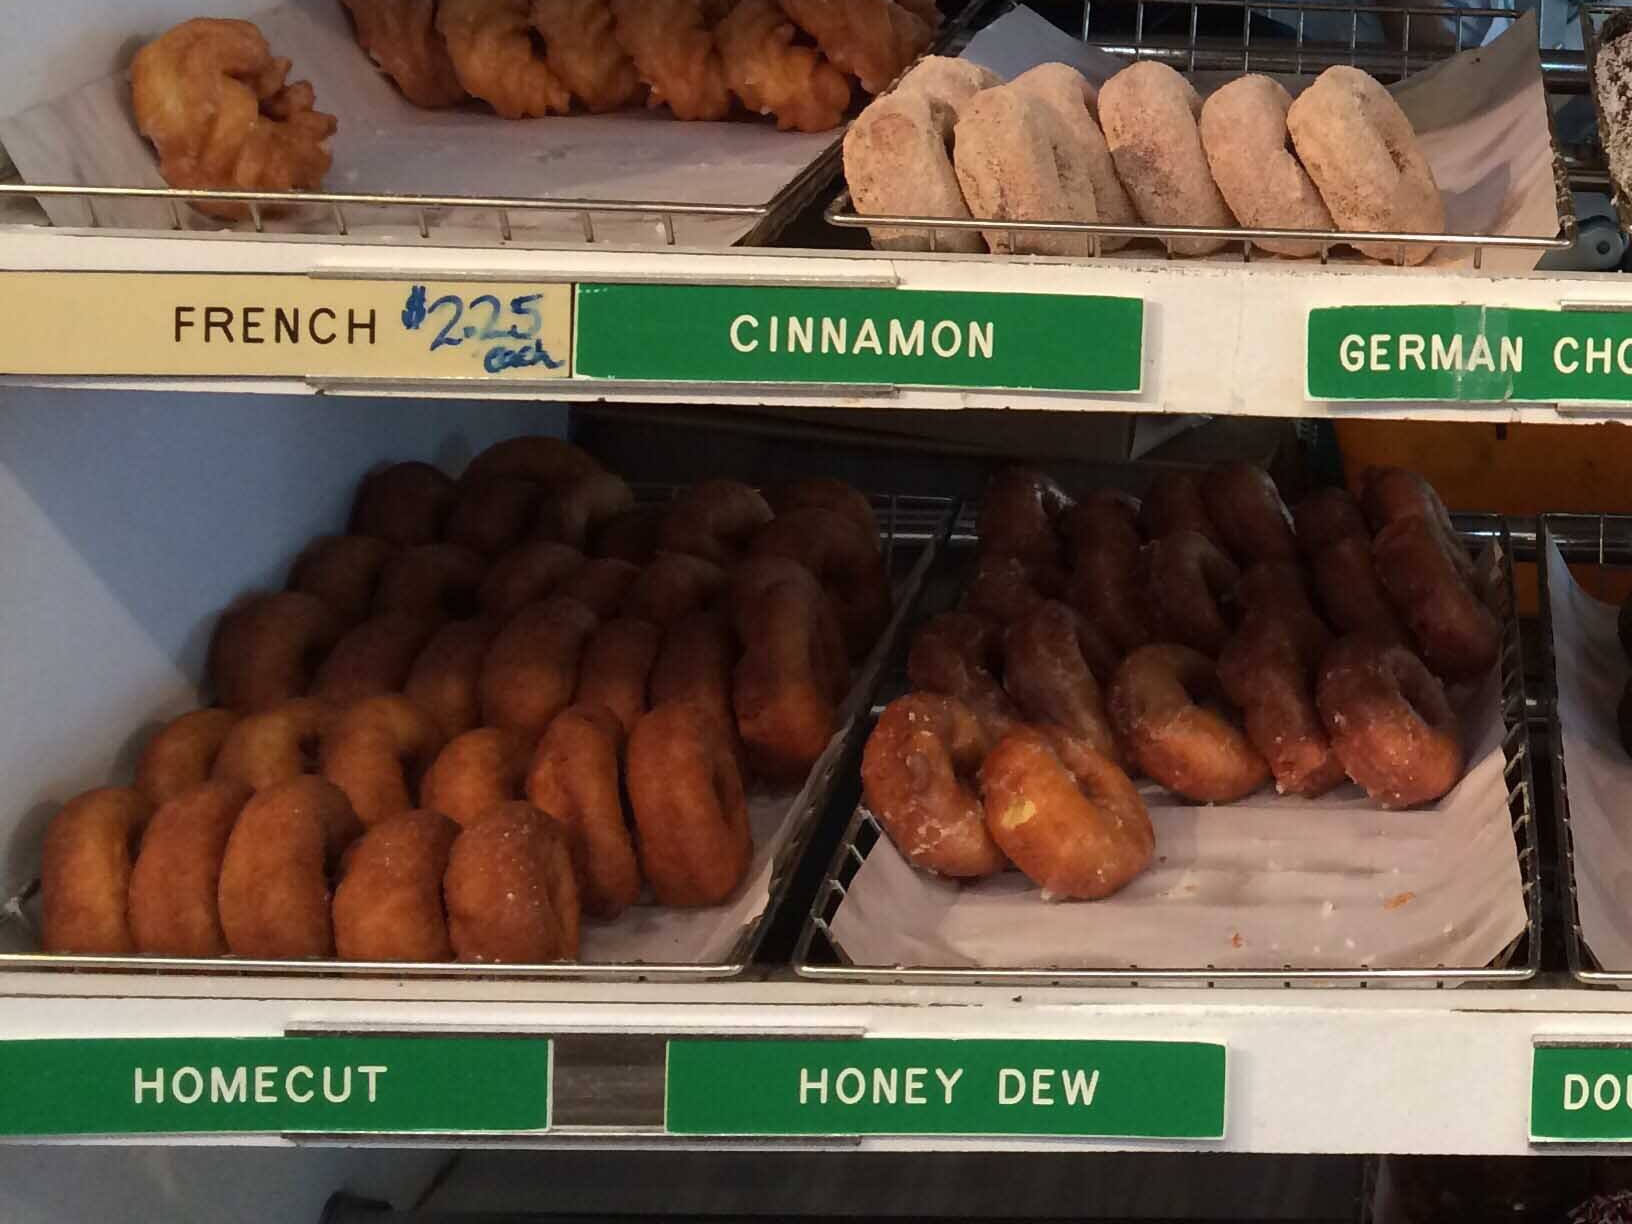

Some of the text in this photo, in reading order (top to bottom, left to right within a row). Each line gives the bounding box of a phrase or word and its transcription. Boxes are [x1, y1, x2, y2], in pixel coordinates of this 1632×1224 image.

[173, 305, 377, 346] FRENCH
[728, 313, 995, 360] CINNAMON
[1338, 330, 1524, 374] GERMAN
[133, 1064, 389, 1105] HOMECUT
[798, 1066, 1101, 1107] HONEY DEW
